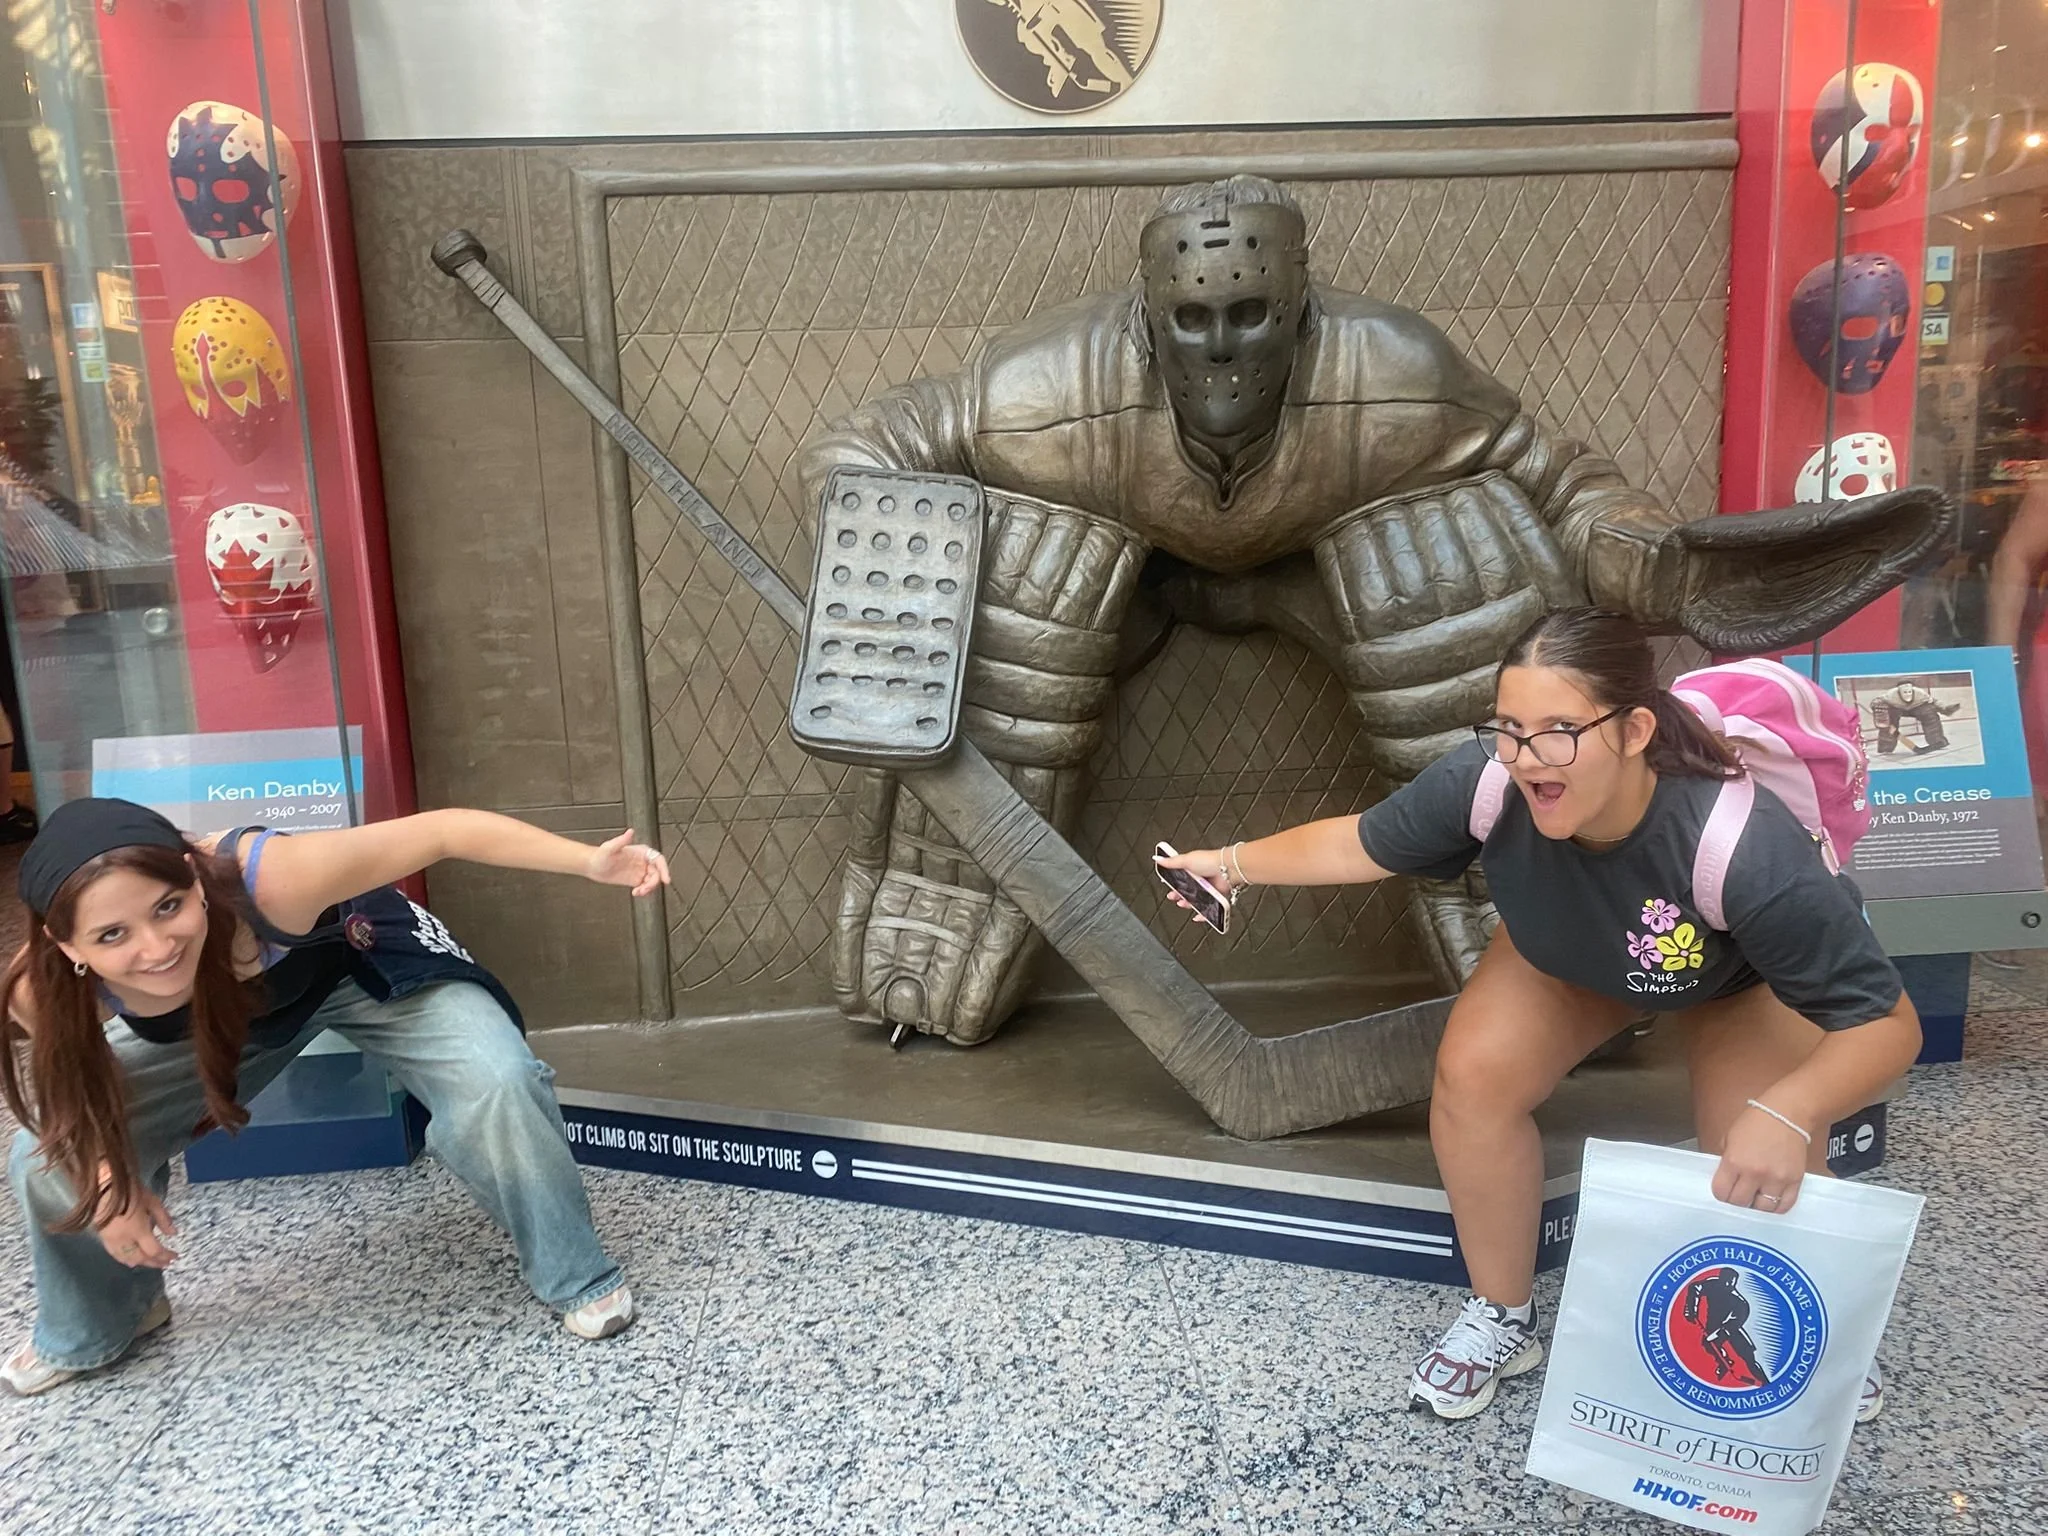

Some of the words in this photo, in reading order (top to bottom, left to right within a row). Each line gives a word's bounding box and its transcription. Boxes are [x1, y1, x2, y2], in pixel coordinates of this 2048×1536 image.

[604, 411, 768, 584] NORTHLAND
[208, 783, 255, 801] Ken
[264, 778, 341, 799] Danby
[266, 806, 295, 820] 1940
[310, 803, 342, 816] 2007
[1873, 790, 1907, 805] the
[1914, 787, 1992, 804] Crease
[1869, 815, 1879, 828] y
[1881, 812, 1906, 825] Ken
[1907, 810, 1950, 825] Danby,
[1952, 810, 1979, 823] 1972
[586, 1124, 626, 1149] CLIMB
[628, 1129, 646, 1152] OR
[649, 1132, 670, 1154] SIT
[672, 1135, 691, 1158] ON
[693, 1137, 720, 1161] THE
[722, 1141, 803, 1172] SCULPTURE
[1668, 1247, 1719, 1283] HOCKEY
[1724, 1247, 1765, 1268] HALL
[1768, 1264, 1783, 1277] of
[1781, 1272, 1812, 1311] FAME
[1647, 1307, 1668, 1365] TEMPLE
[1662, 1365, 1677, 1379] de
[1687, 1385, 1777, 1409] RENOMMÉE
[1778, 1383, 1793, 1398] du
[1789, 1324, 1817, 1384] HOCKEY
[1570, 1400, 1670, 1449] SPIRIT
[1676, 1437, 1707, 1462] of
[1707, 1439, 1825, 1477] HOCKEY
[1632, 1477, 1758, 1524] HHOF.com
[1648, 1465, 1703, 1488] TORONTO,
[1706, 1481, 1752, 1498] CANADA
